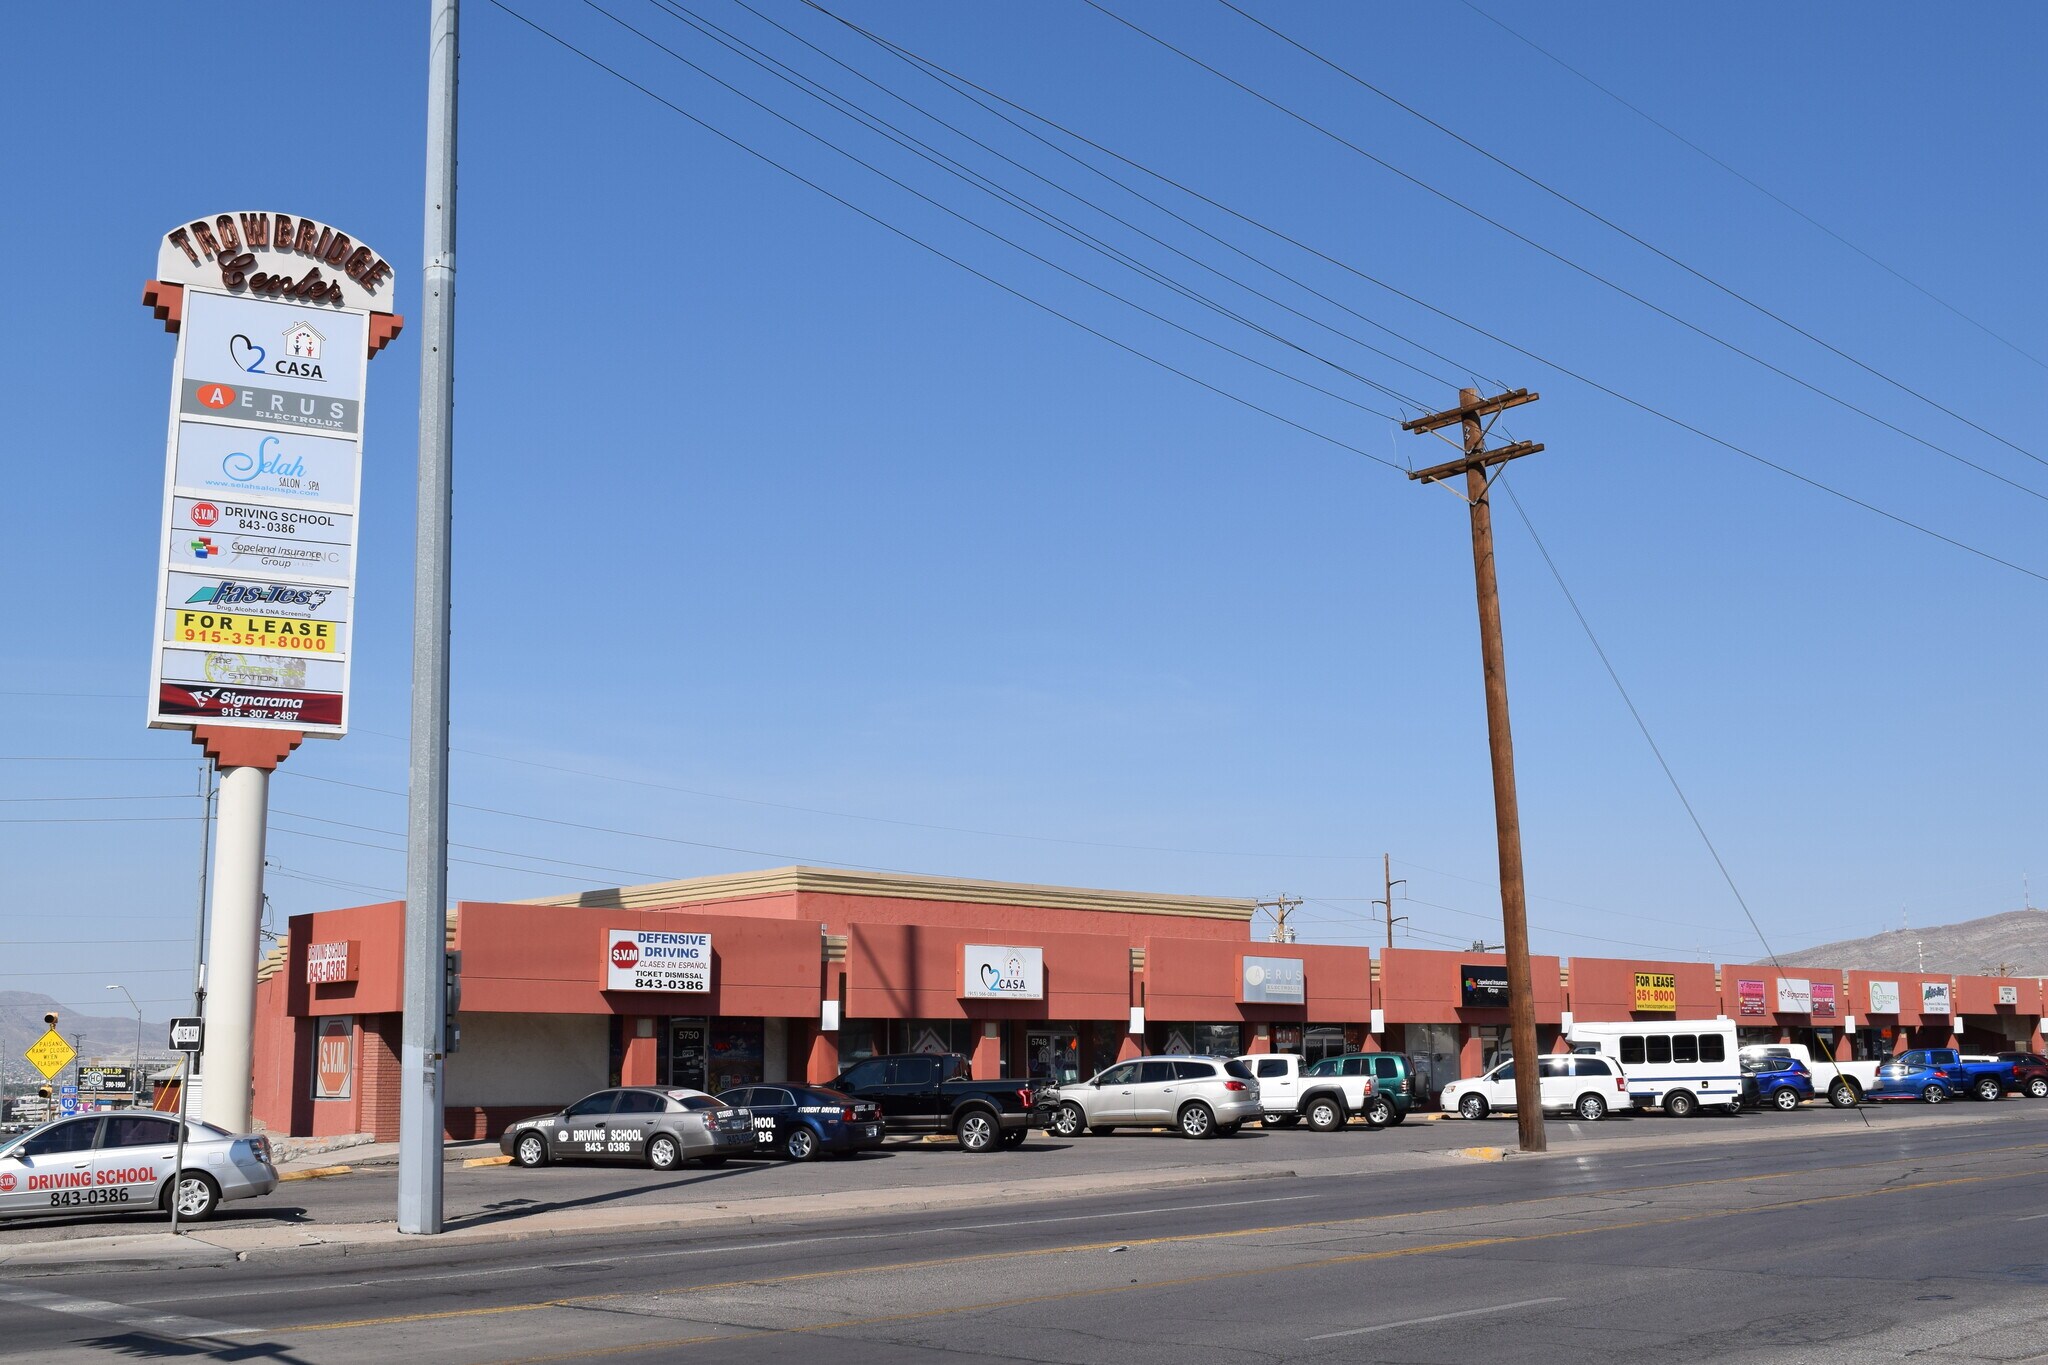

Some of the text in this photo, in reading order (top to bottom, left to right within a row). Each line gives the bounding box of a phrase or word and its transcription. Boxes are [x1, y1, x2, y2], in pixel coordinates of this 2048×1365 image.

[168, 213, 390, 290] TROWBRIDGE
[217, 250, 343, 302] Center
[275, 360, 323, 379] CASA
[210, 388, 344, 419] AERUS
[256, 410, 344, 428] ELECTROLUX
[223, 435, 307, 481] Selah
[205, 479, 319, 496] www.selahsalonspa.com
[279, 477, 320, 491] SALON SPA
[194, 508, 216, 521] S.V.M.
[225, 506, 335, 527] DRIVING SCHOOL
[239, 520, 296, 534] 843-0386
[231, 541, 321, 559] Copeland Insurance
[261, 557, 291, 568] Group
[281, 610, 312, 618] Screening
[184, 613, 328, 637] FOR LEASE
[185, 629, 326, 650] 915-351-8000
[228, 673, 278, 682] STATION
[219, 691, 304, 709] Signarama
[638, 932, 707, 945] DEFENSIVE
[612, 949, 638, 961] S.V.M
[644, 946, 699, 959] DRIVING
[309, 960, 345, 982] 843-0386
[639, 960, 665, 969] CLASES
[667, 961, 676, 969] EN
[635, 970, 703, 979] TICKET DISMISSAL
[635, 978, 704, 991] 843-0386
[999, 979, 1025, 989] CASA
[1636, 976, 1674, 988] FOR LEASE
[1637, 989, 1674, 1001] 351-8000
[178, 1028, 199, 1039] ONE WAY
[679, 1031, 699, 1039] 5750
[1032, 1038, 1047, 1046] 5748
[321, 1041, 346, 1074] S.V.M.
[65, 1099, 74, 1107] 10
[821, 1106, 840, 1114] DRIVER
[516, 1119, 555, 1130] STUDENT DRIVER
[754, 1117, 776, 1128] HOOL
[573, 1129, 606, 1141] DRIVING
[611, 1129, 643, 1141] SCHOOL
[608, 1142, 630, 1152] 0386
[28, 1167, 157, 1190] DRIVING SCHOOL
[51, 1187, 129, 1207] 843-0386
